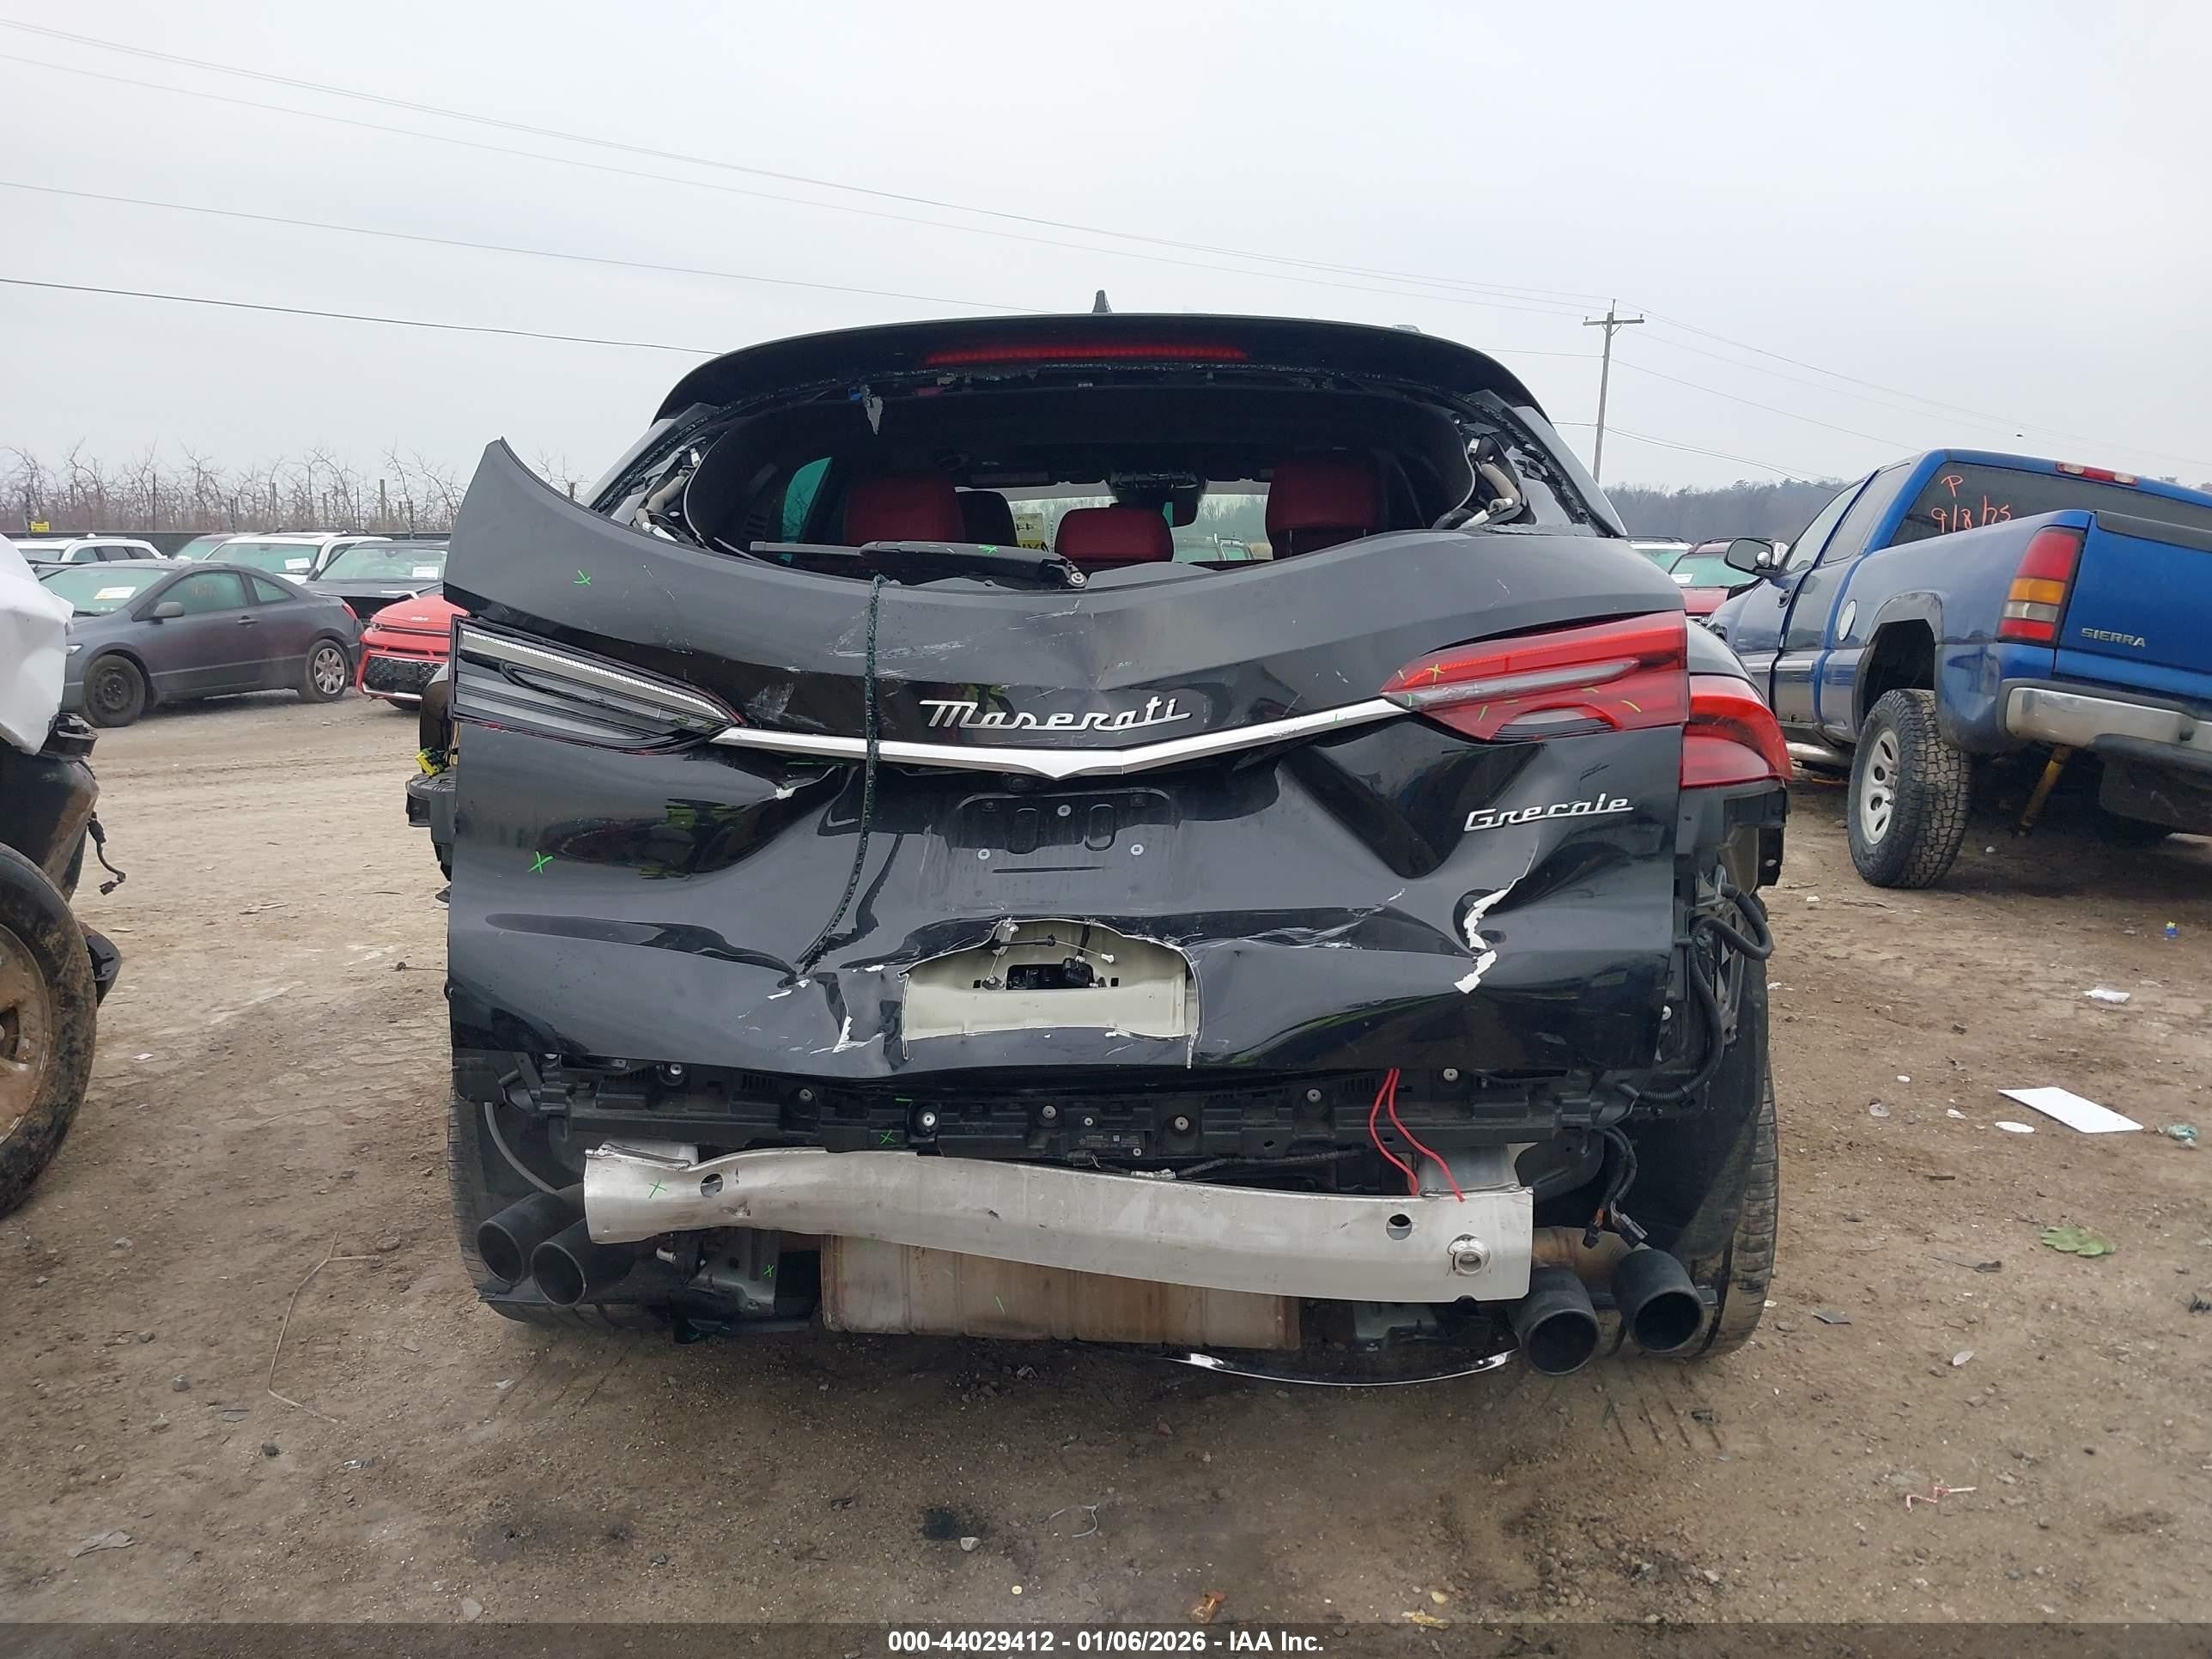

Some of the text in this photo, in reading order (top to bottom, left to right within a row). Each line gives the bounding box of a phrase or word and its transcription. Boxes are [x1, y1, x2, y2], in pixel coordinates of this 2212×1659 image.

[1941, 474, 1964, 497] P
[2081, 627, 2146, 647] SIERRA
[919, 696, 1192, 732] Maserati
[1463, 792, 1635, 832] Grecale
